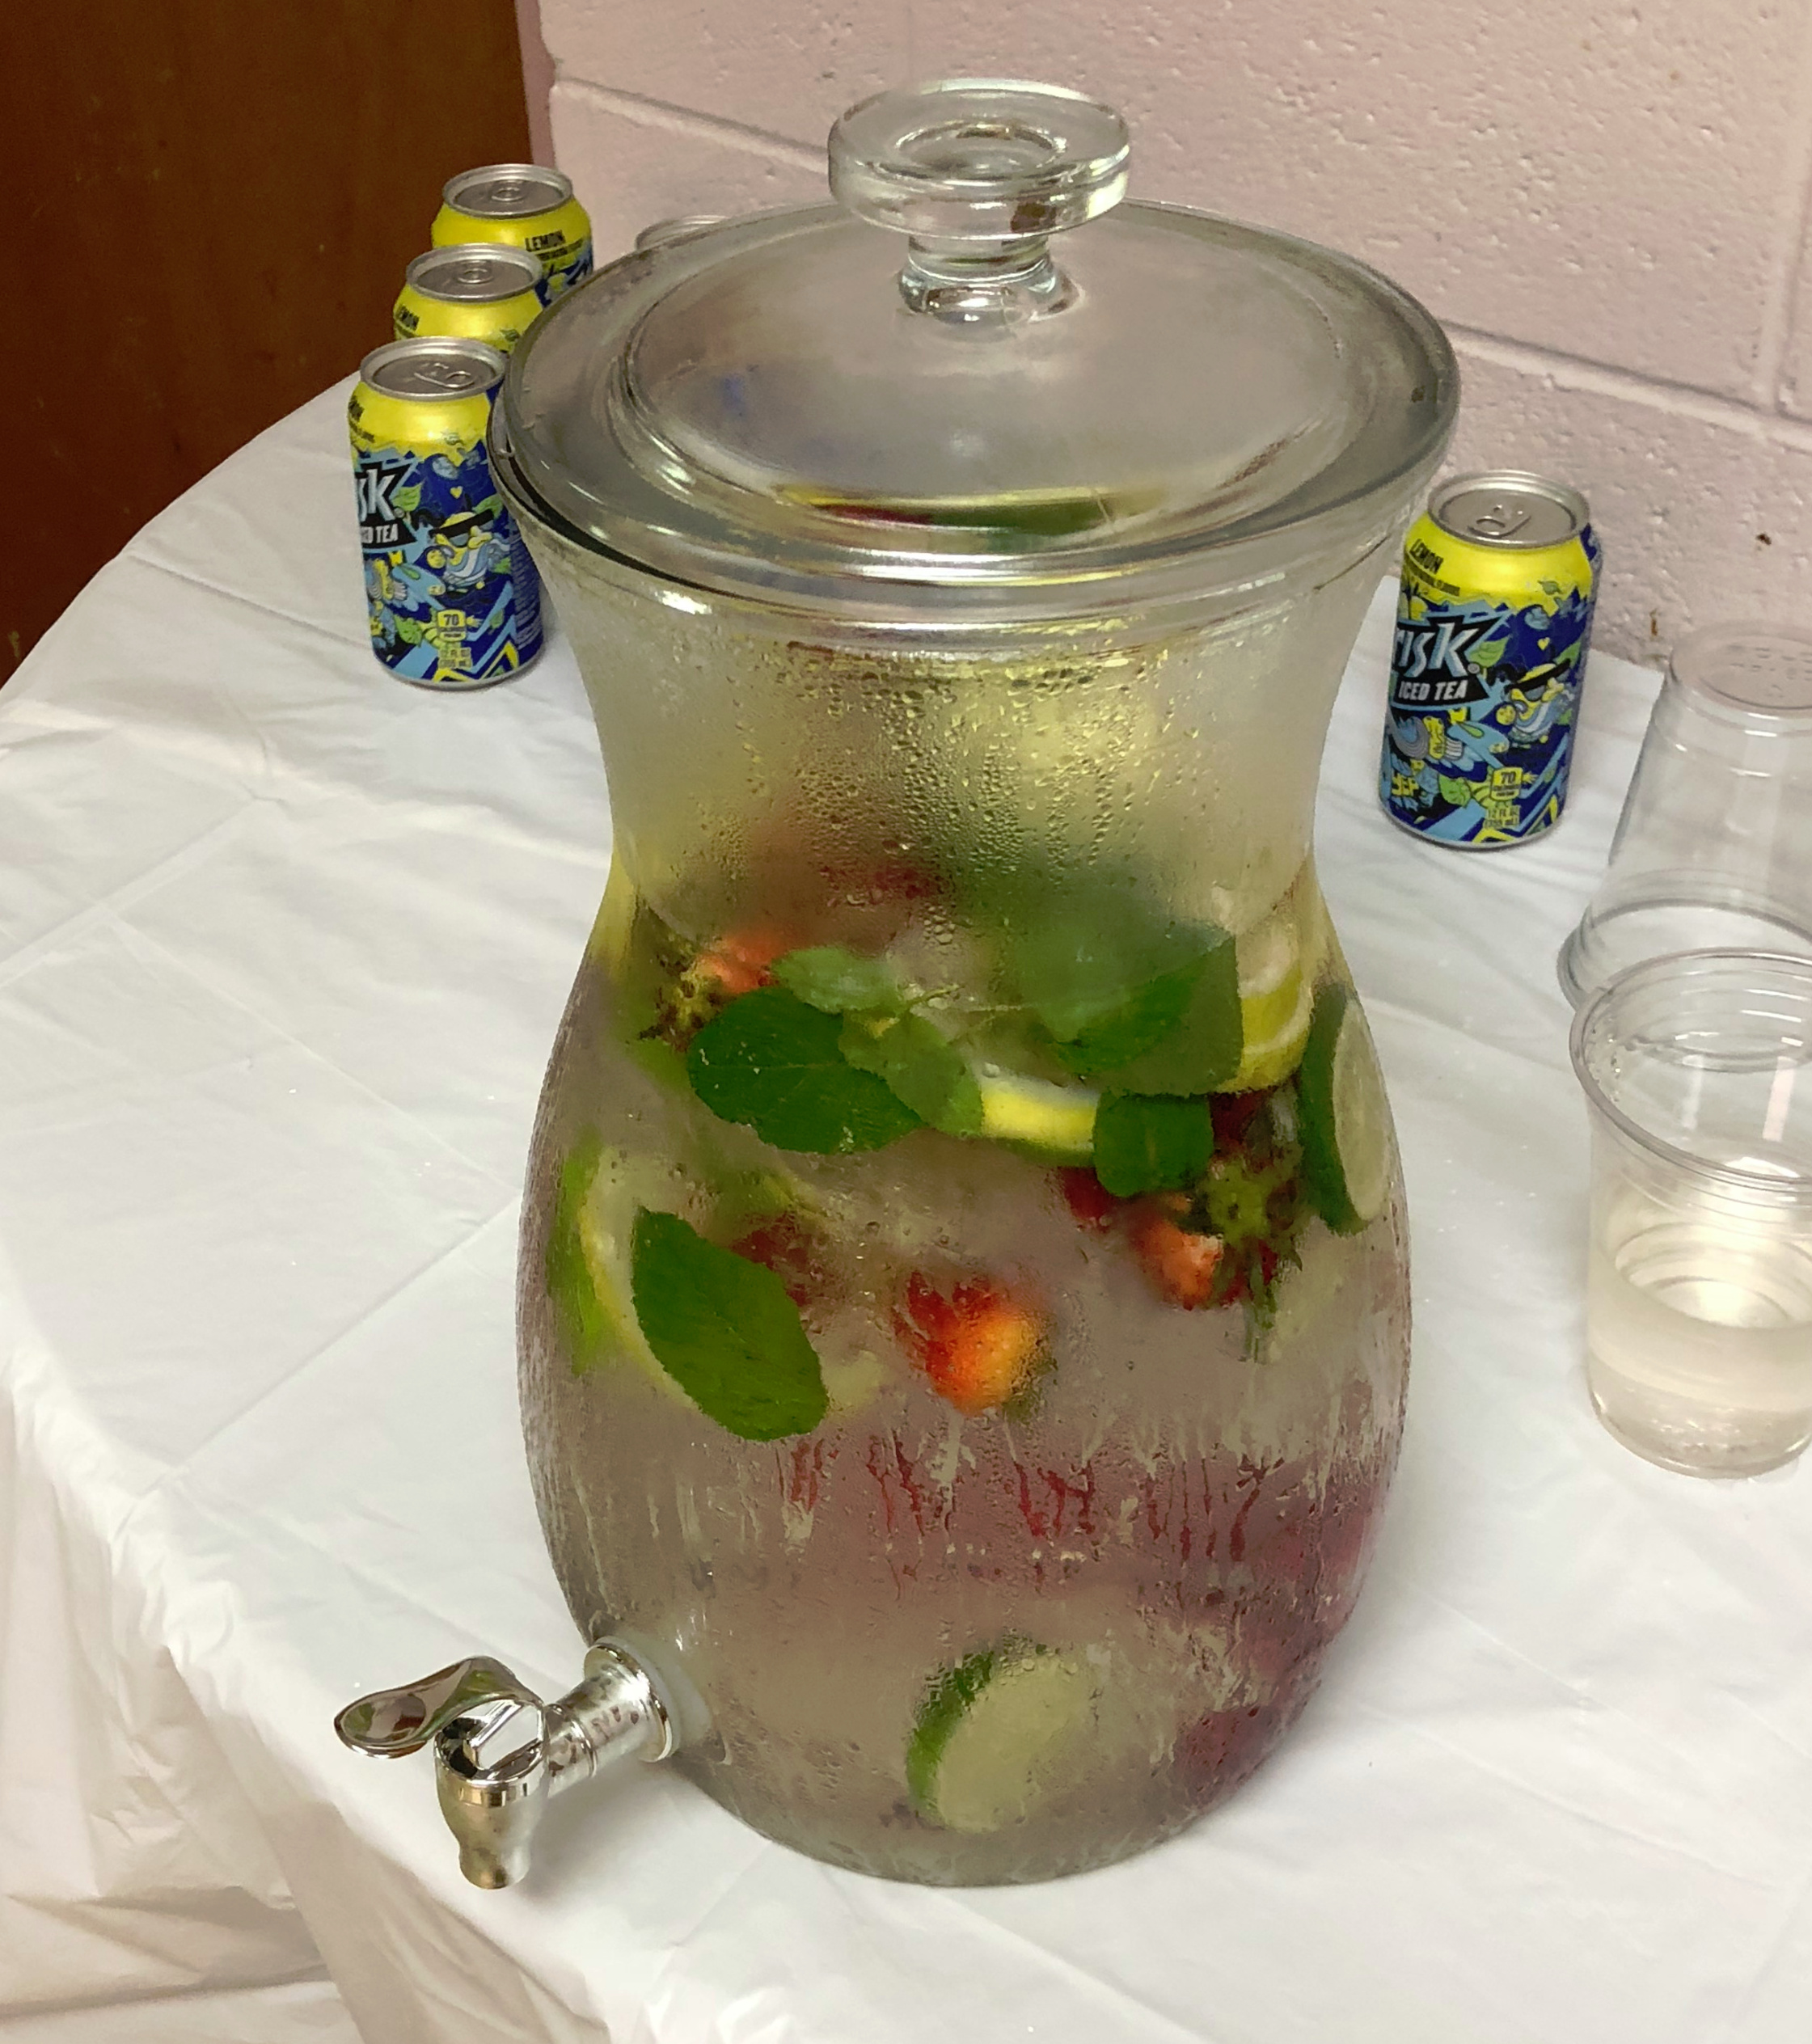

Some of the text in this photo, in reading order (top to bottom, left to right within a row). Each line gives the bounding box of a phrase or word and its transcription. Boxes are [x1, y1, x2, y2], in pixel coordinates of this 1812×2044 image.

[525, 230, 566, 252] LEMON
[375, 523, 399, 543] TEA
[1409, 538, 1444, 576] LEMON
[443, 613, 460, 626] 70
[1398, 679, 1468, 701] ICED TEA
[1501, 771, 1517, 784] 70
